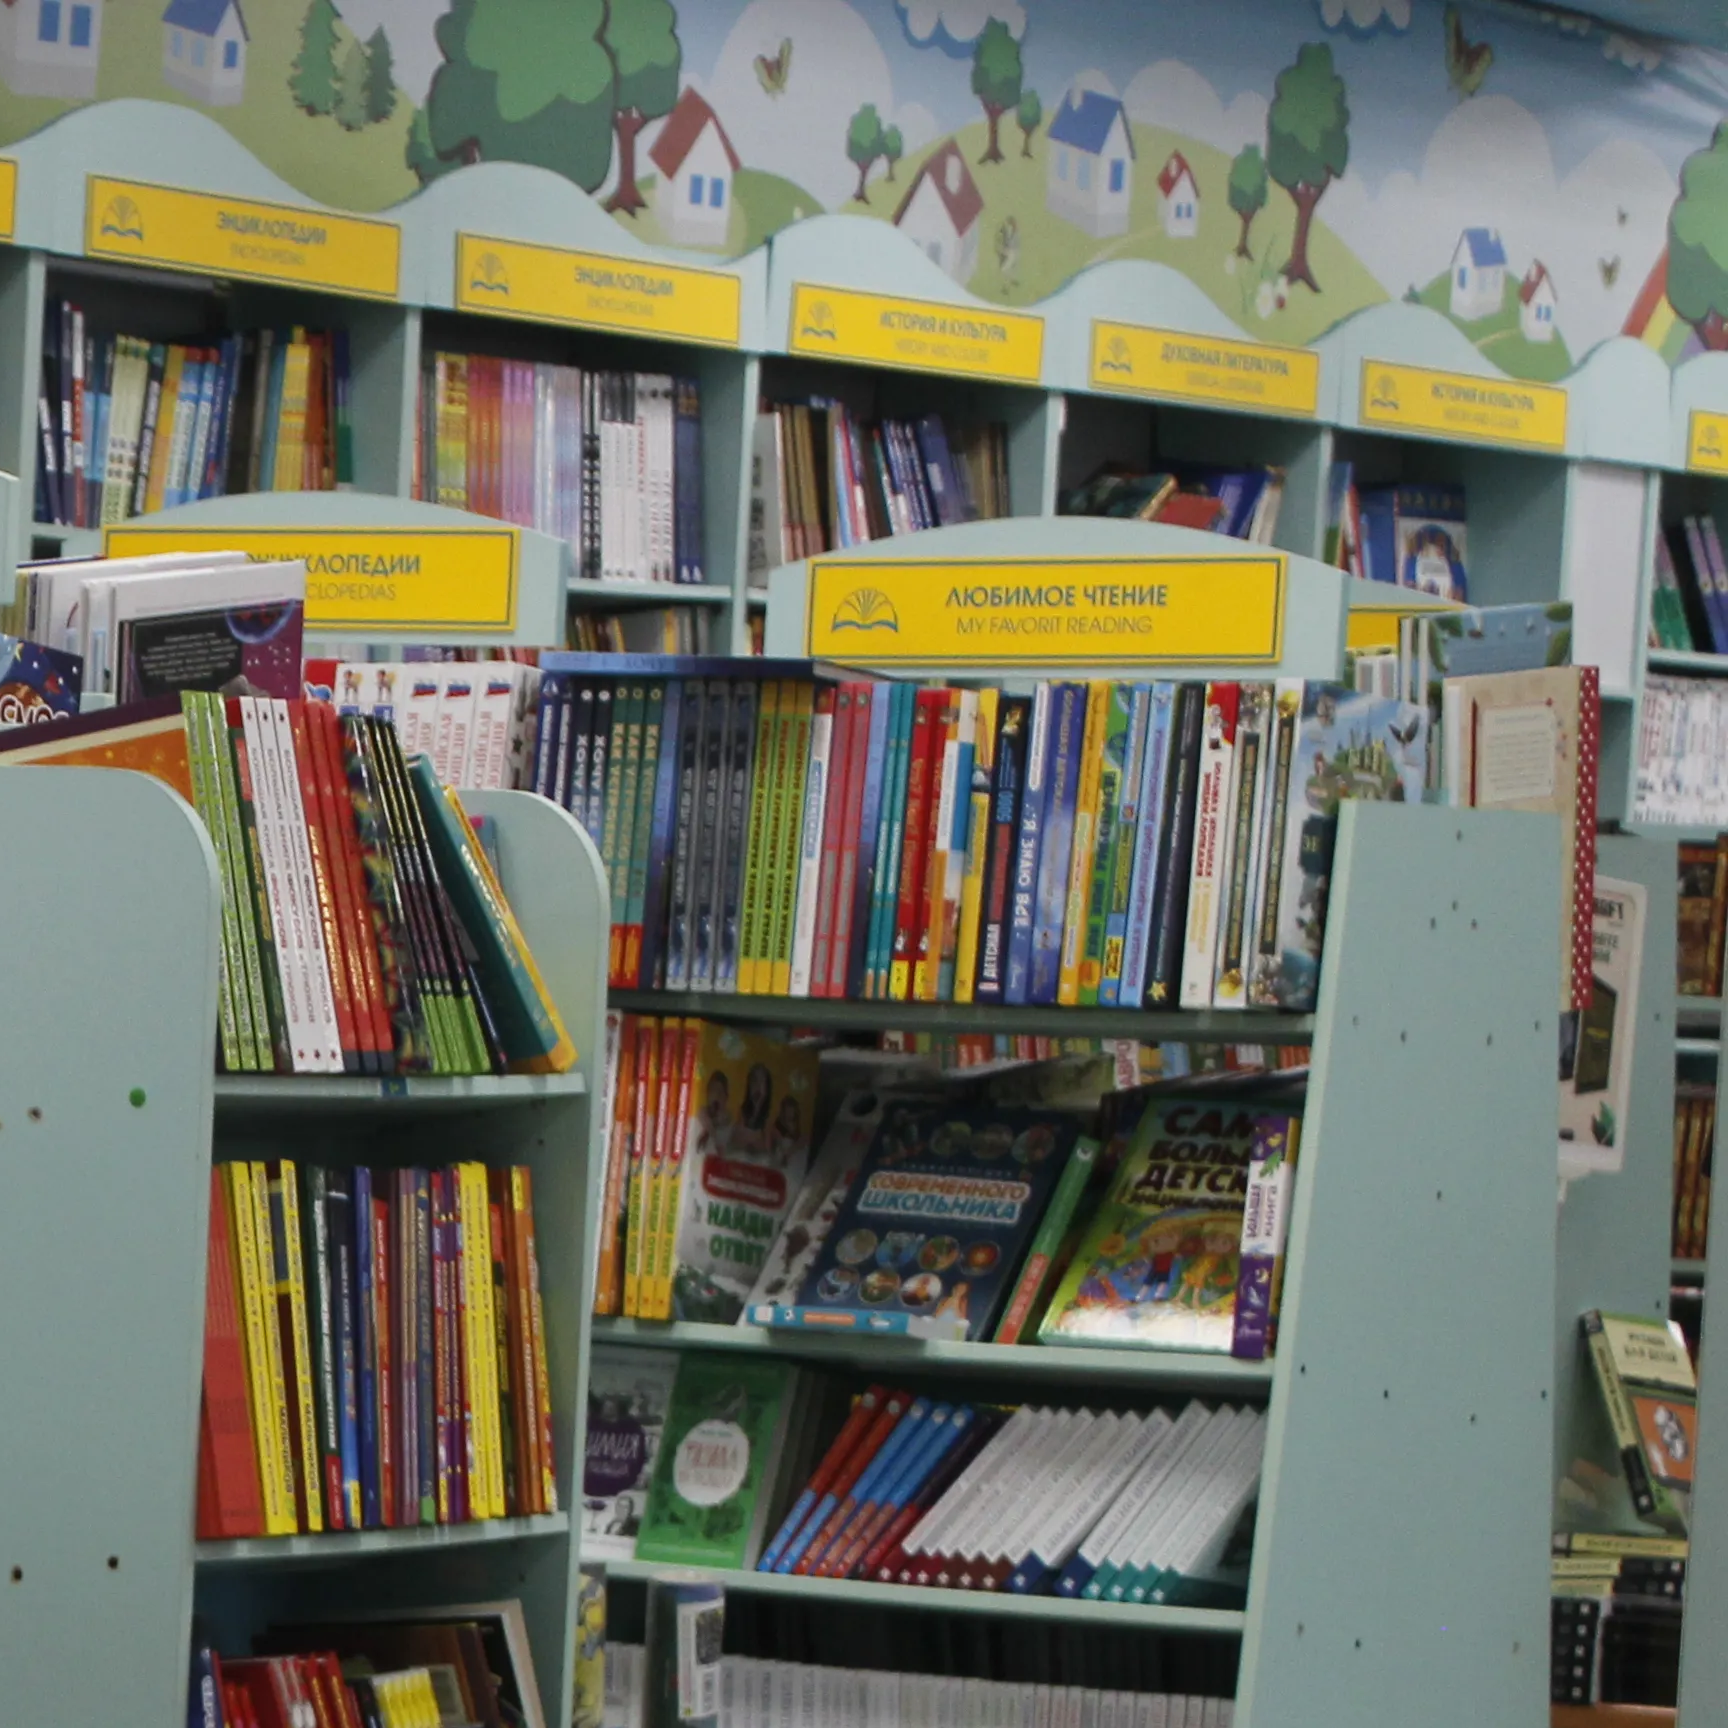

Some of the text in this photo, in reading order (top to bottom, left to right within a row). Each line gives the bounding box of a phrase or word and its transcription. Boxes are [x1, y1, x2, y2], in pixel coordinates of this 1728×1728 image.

[216, 210, 328, 245] ЭНЦИКЛОПЕДИИ
[304, 582, 398, 602] CLOPEDIAS
[945, 583, 1169, 608] ЛЮБИМОЕ ЧТЕНИЕ
[956, 615, 1153, 636] MY FAVORIT READING
[1163, 1105, 1256, 1139] САМ
[1149, 1140, 1250, 1167] БОЛЬ
[1135, 1163, 1250, 1193] ДЕТСК
